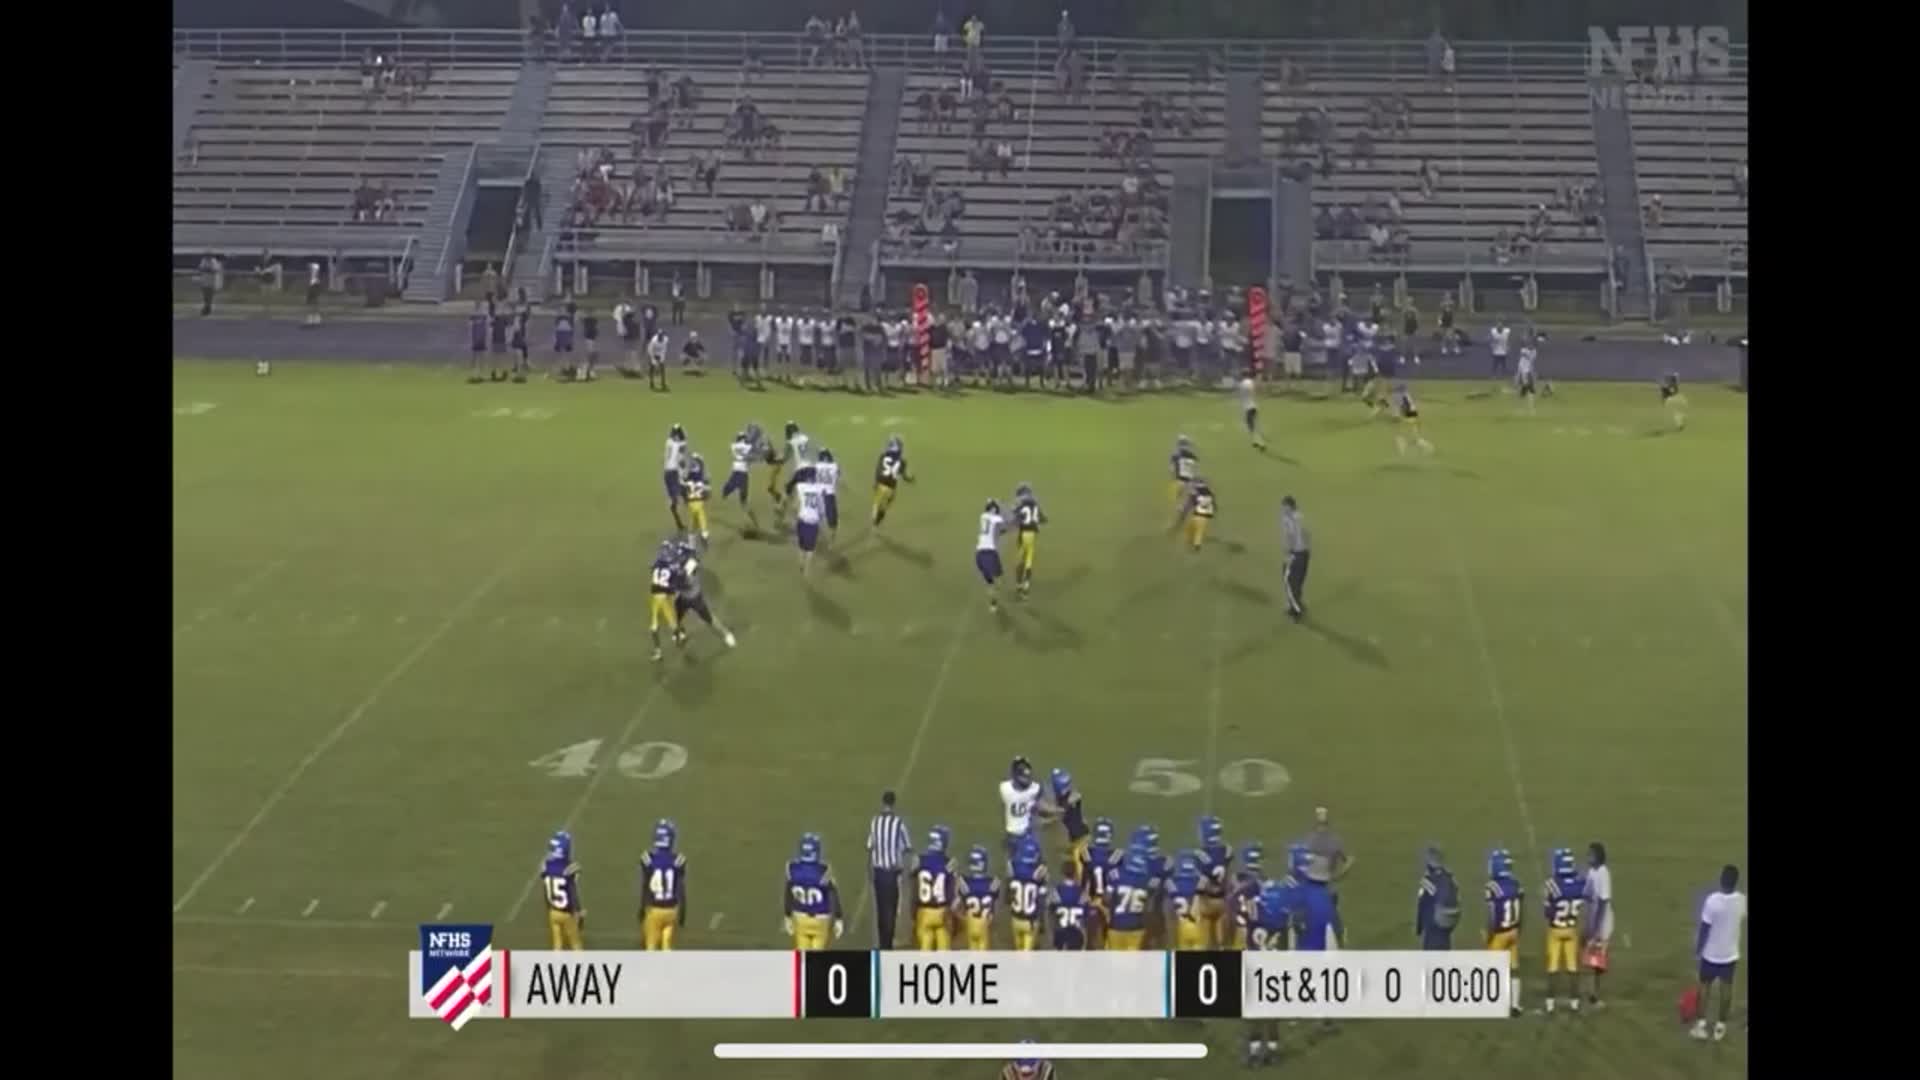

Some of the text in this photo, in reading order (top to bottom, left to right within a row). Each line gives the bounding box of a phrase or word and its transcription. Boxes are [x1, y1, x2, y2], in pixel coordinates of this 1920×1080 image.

[528, 738, 688, 779] 40
[1128, 758, 1291, 797] 50
[545, 876, 567, 908] 15
[650, 868, 675, 900] 41
[918, 869, 946, 904] 64
[1010, 880, 1037, 914] 30
[1115, 885, 1148, 913] 76
